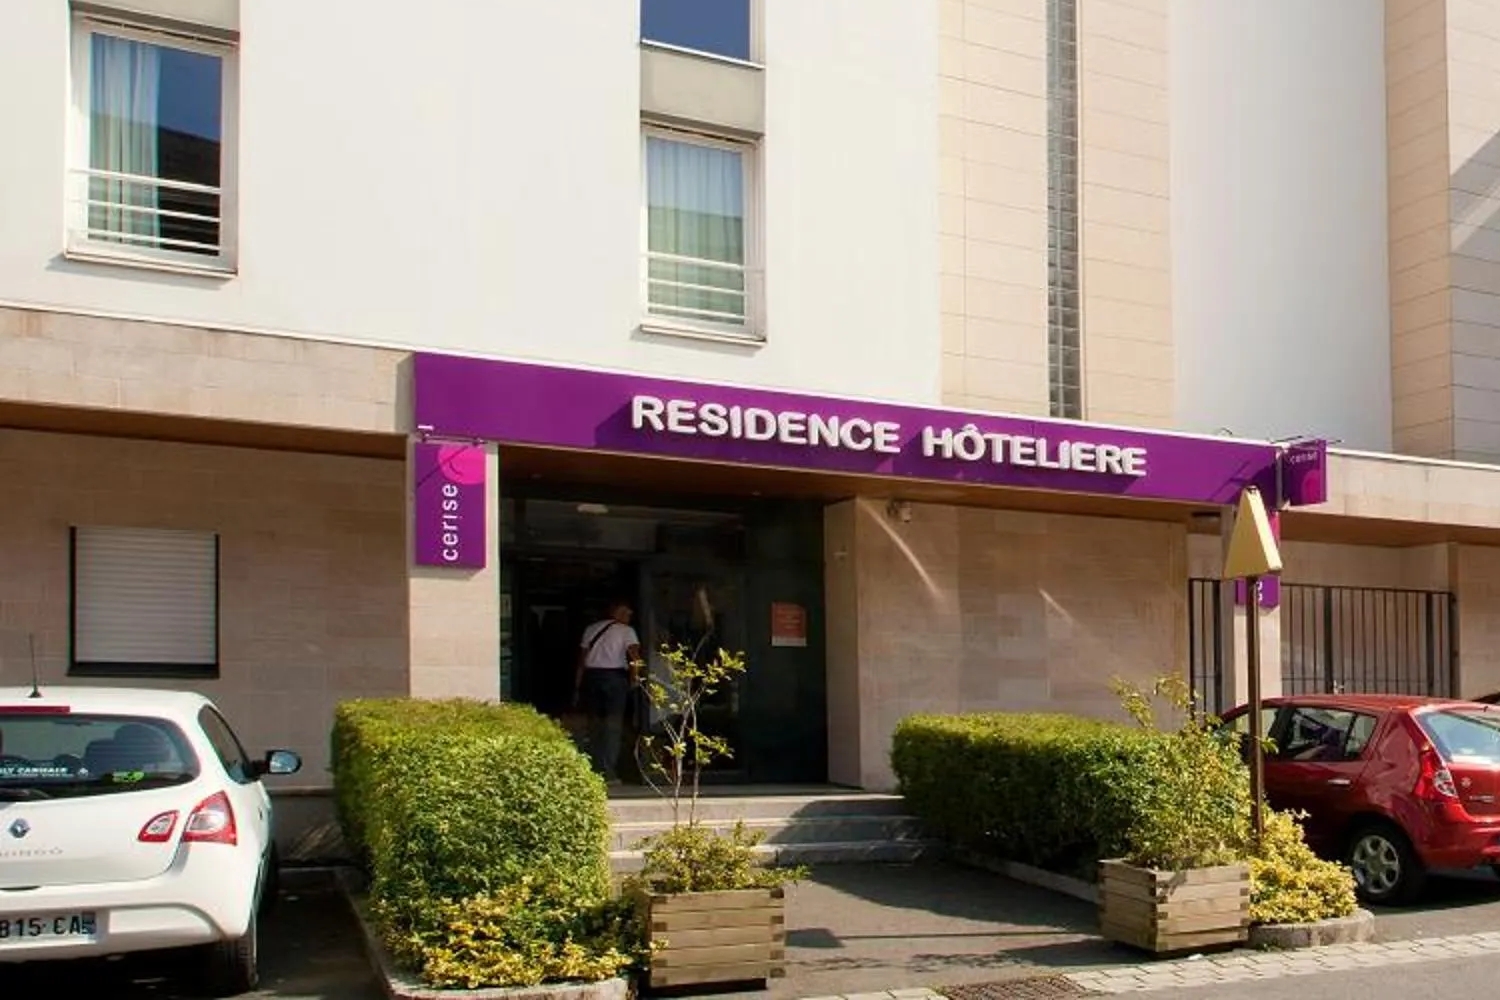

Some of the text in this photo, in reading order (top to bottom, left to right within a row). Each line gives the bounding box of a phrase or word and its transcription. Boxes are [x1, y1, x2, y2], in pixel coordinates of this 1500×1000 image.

[632, 395, 1147, 477] RESIDENCE HÔTELIERE
[442, 483, 459, 561] cerise
